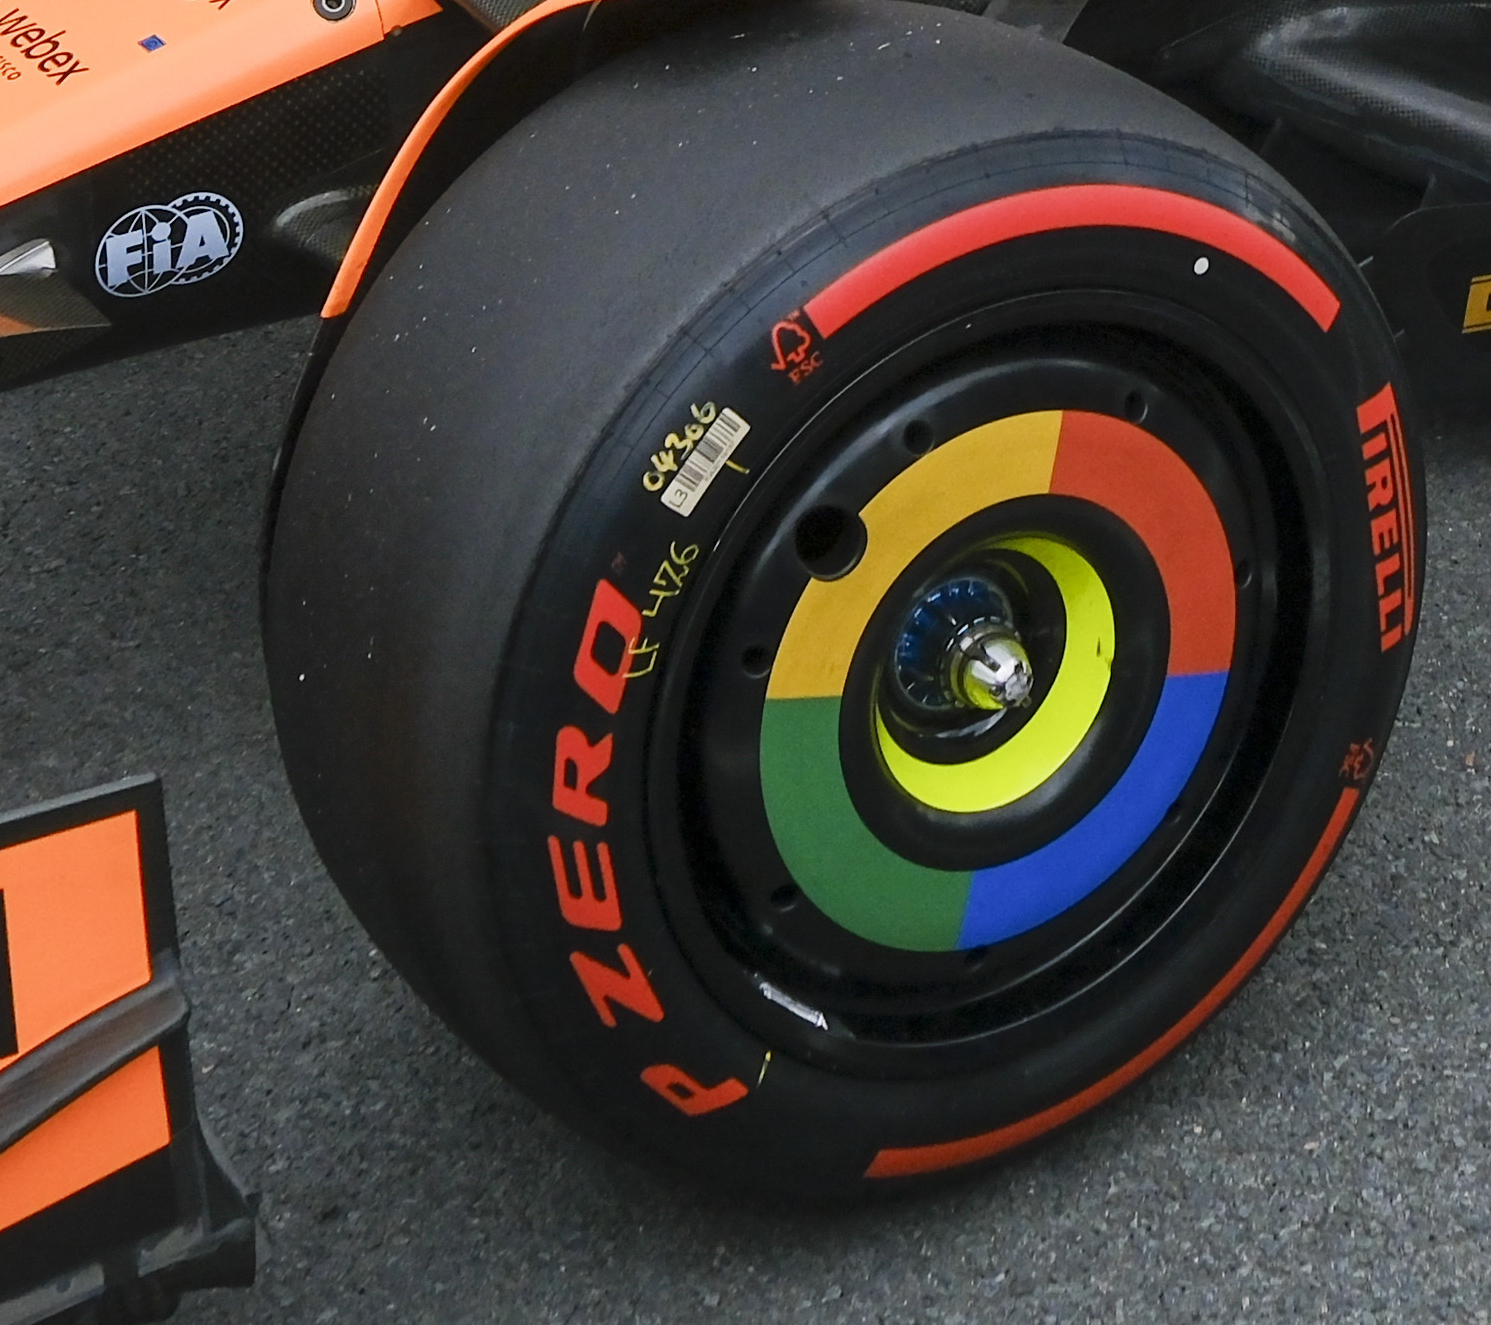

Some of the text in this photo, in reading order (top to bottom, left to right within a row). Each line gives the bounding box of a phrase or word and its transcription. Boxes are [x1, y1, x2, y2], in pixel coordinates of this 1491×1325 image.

[102, 208, 234, 288] FIA
[787, 350, 827, 387] FSC
[1356, 381, 1416, 654] PIRELLI
[550, 577, 664, 1030] ZERO
